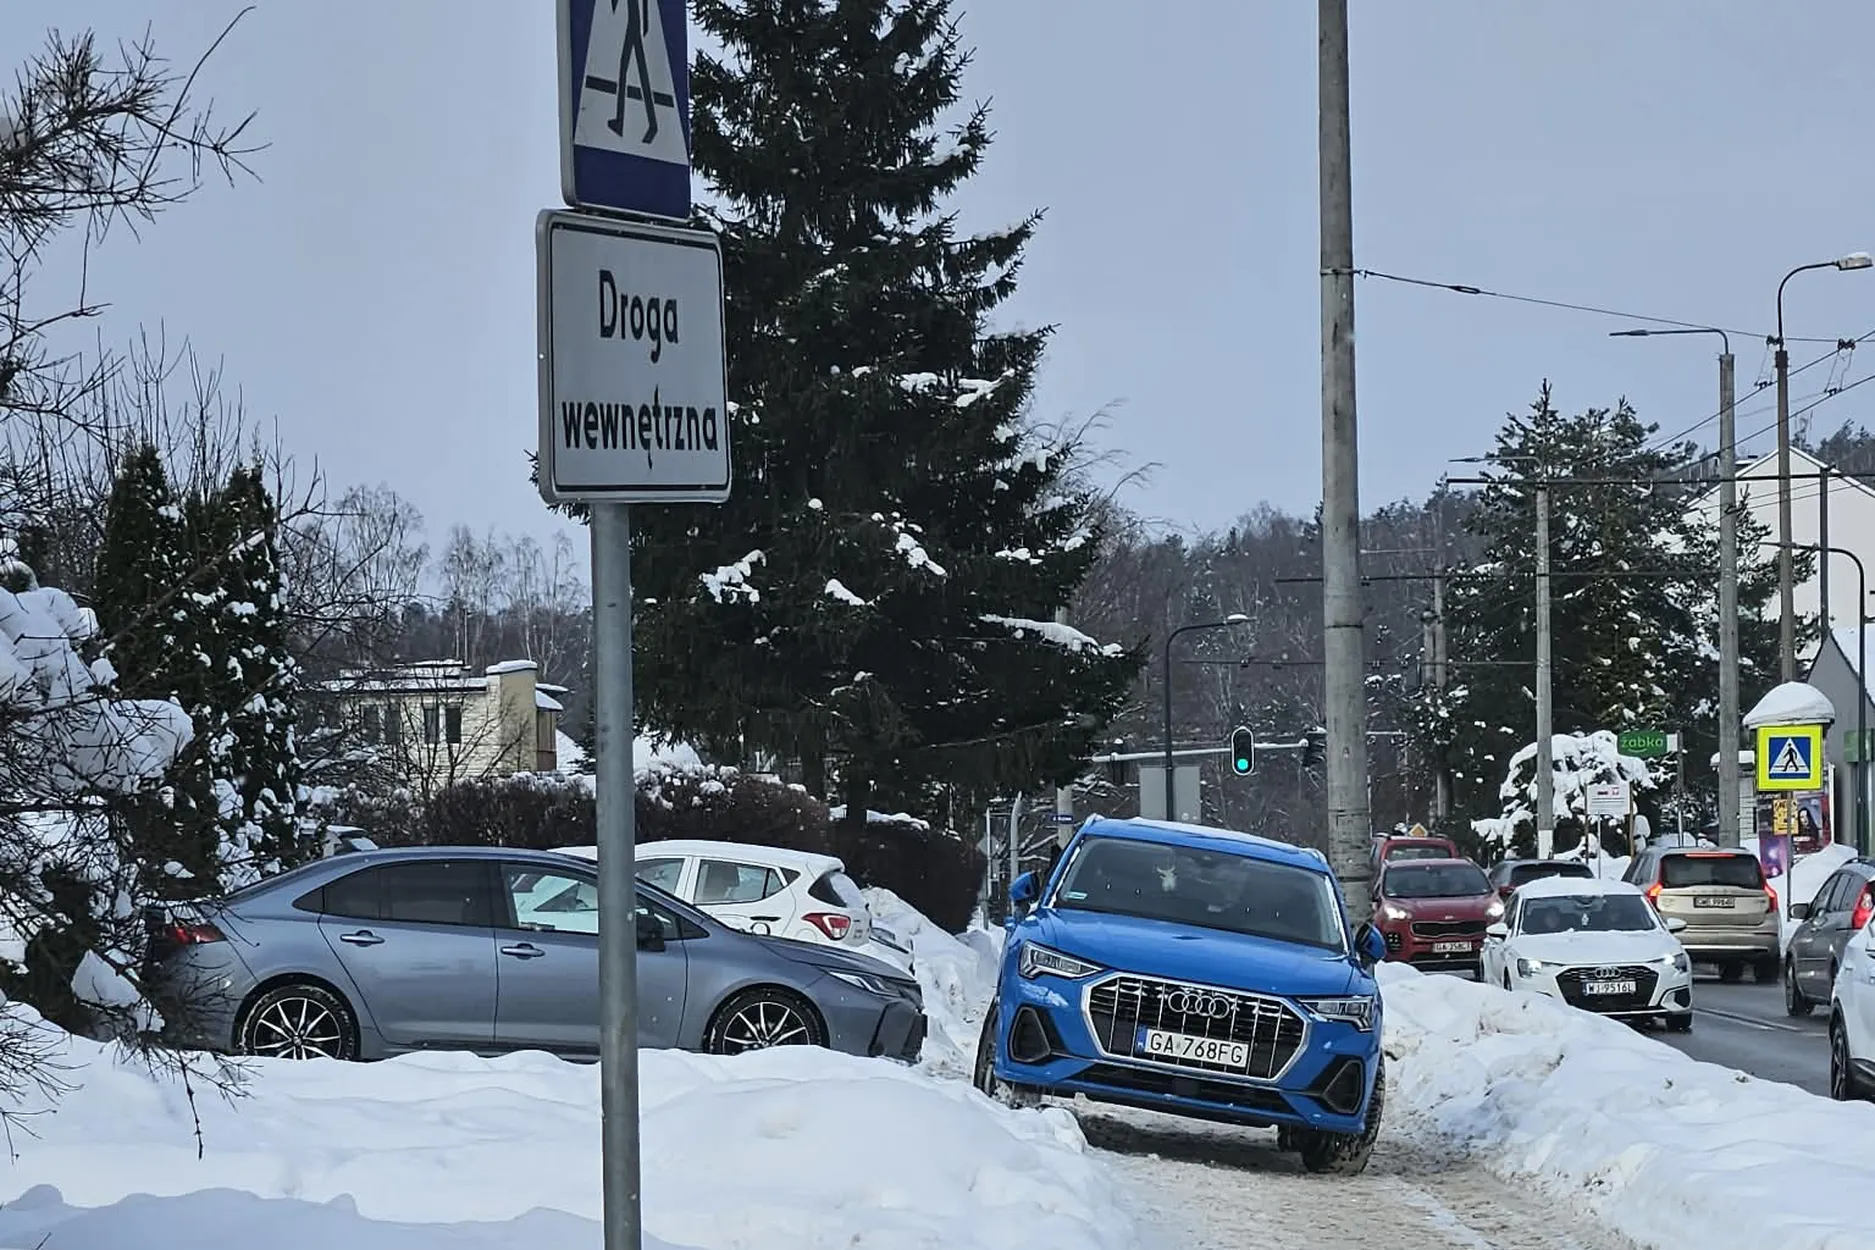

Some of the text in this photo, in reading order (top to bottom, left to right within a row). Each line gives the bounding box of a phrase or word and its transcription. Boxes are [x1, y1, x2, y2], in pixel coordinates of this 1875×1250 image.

[599, 268, 679, 364] Droga
[561, 384, 719, 470] wewnętrzna
[1149, 1032, 1243, 1064] GA 768FG
